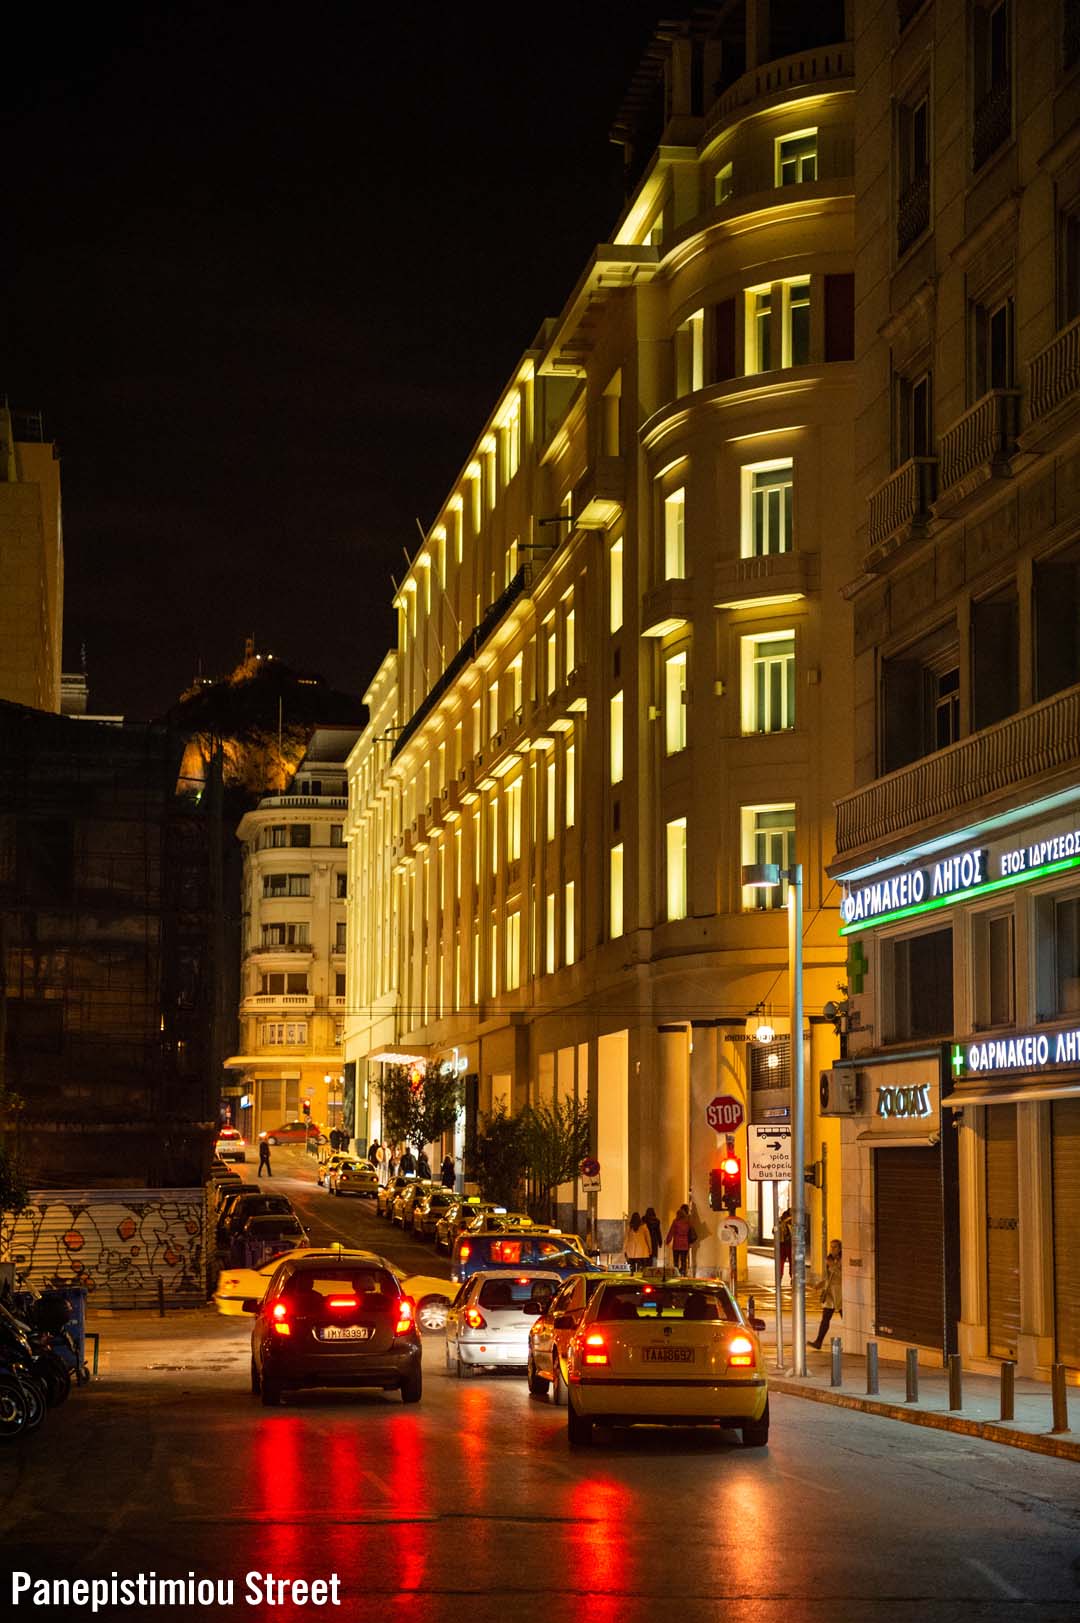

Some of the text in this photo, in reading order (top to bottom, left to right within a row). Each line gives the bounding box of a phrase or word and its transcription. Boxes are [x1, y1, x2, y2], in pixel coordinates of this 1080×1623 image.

[1001, 848, 1026, 876] ΕΤΟΣ
[844, 850, 982, 923] ΦΑΡΜΑΚΕΙΟ ΛΗΤΟΣ
[969, 1035, 1049, 1071] ΦΑΡΜΑΚΕΙΟ
[708, 1104, 741, 1125] STOP
[758, 1170, 792, 1178] Bus lane
